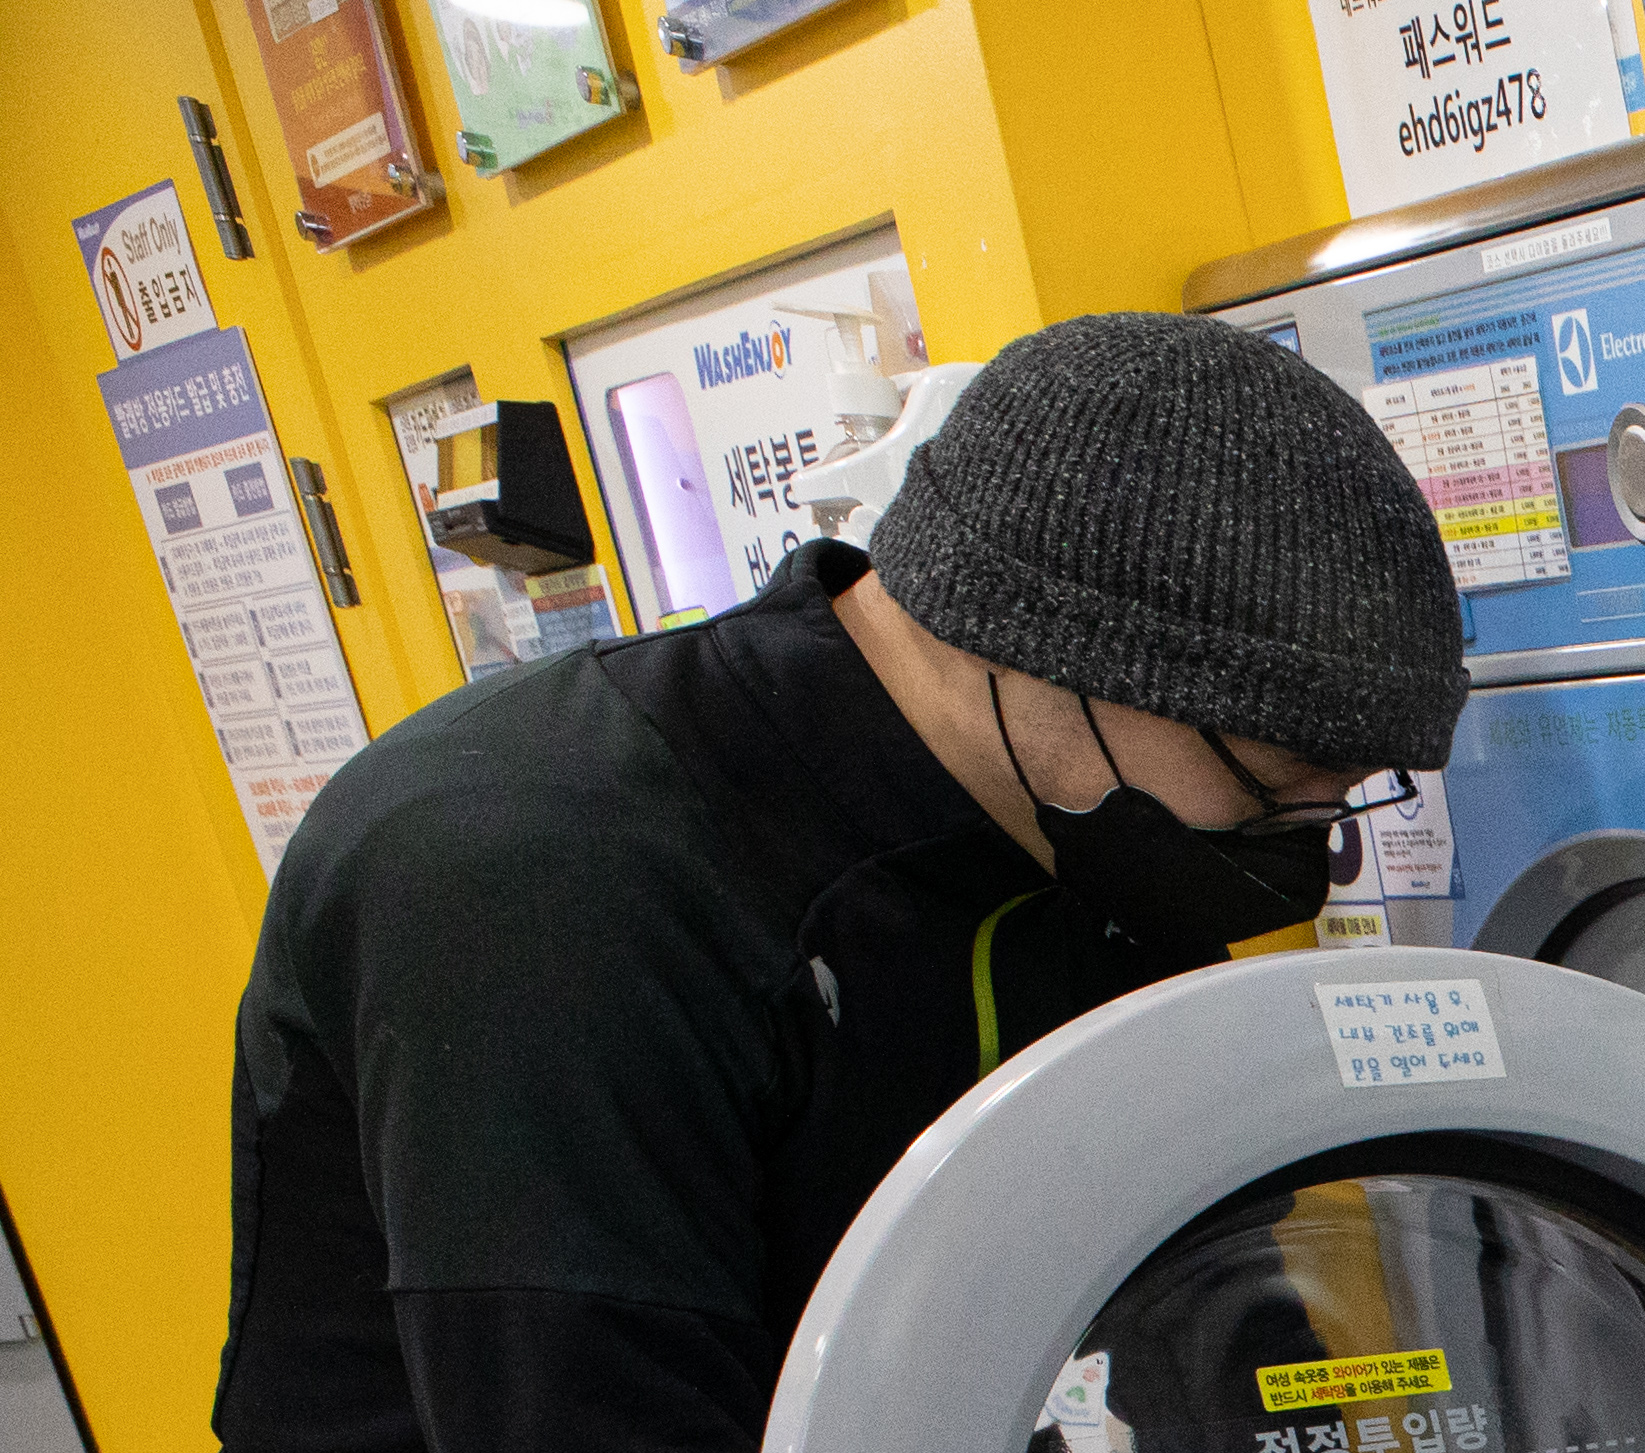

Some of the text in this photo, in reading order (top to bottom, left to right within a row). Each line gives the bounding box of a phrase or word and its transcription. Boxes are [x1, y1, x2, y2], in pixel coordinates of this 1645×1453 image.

[1399, 0, 1511, 80] 패스워드
[1399, 68, 1547, 156] ehd6igz478
[122, 222, 151, 264] Staff
[150, 213, 181, 253] Only
[139, 264, 201, 324] 출입금지
[1404, 991, 1439, 1015] 사용
[1339, 1020, 1479, 1046] 내부 건조를 위해
[1352, 1057, 1383, 1081] 문을
[1390, 1055, 1427, 1077] 열어
